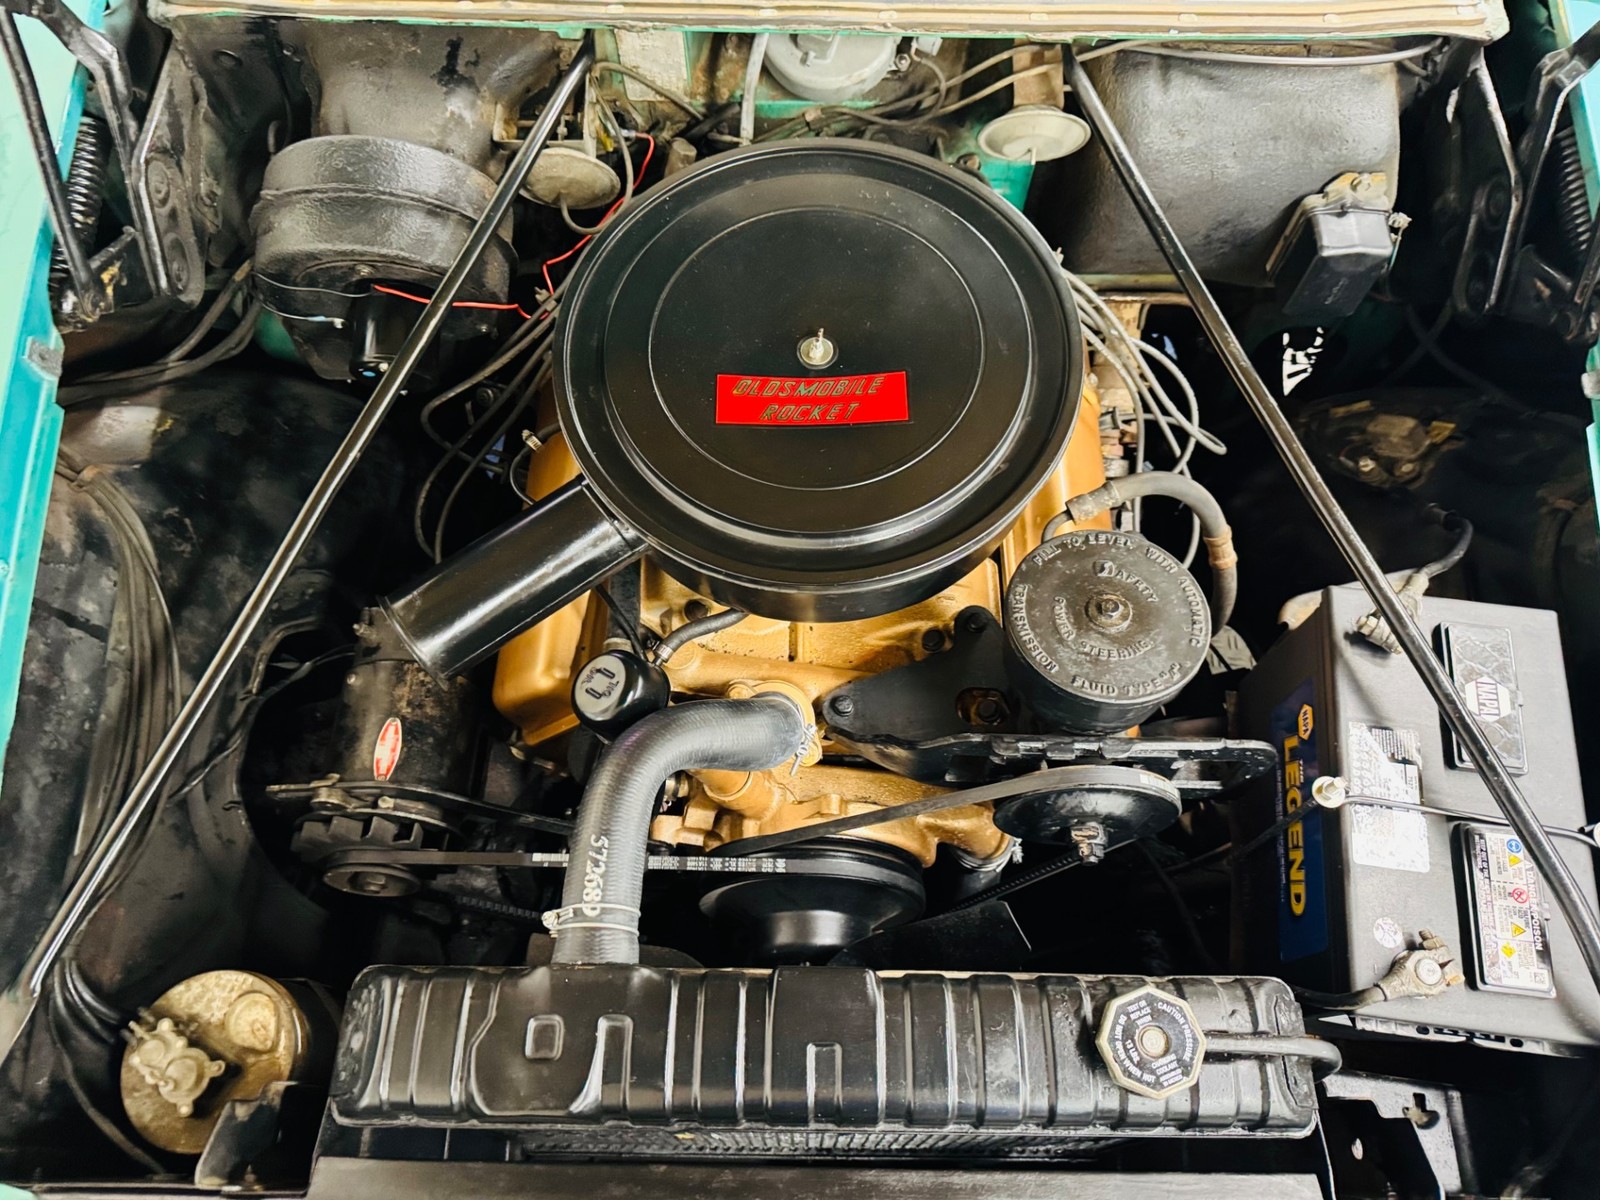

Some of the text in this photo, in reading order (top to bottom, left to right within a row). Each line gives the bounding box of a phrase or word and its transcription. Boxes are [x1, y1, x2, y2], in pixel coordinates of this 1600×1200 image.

[732, 375, 886, 397] OLDSMOBILE
[759, 401, 861, 421] ROCKET
[1032, 533, 1206, 648] FILL TO LEVEL WITH AUTOMATIC
[1012, 583, 1060, 673] TRANSMISSION
[1054, 596, 1076, 641] POWER
[1071, 674, 1118, 696] FLUID
[1122, 677, 1162, 697] TYPE
[1476, 681, 1500, 716] NAPA
[1301, 709, 1309, 735] NAPA
[1284, 735, 1306, 916] LEGEND
[1127, 1003, 1139, 1013] TEST
[1130, 1006, 1152, 1020] REPLACE
[1157, 1002, 1194, 1061] CAUTION PRESSURE
[1115, 1014, 1156, 1083] DO NOT OPEN WHEN HOT
[1156, 1061, 1179, 1075] COOLANT
